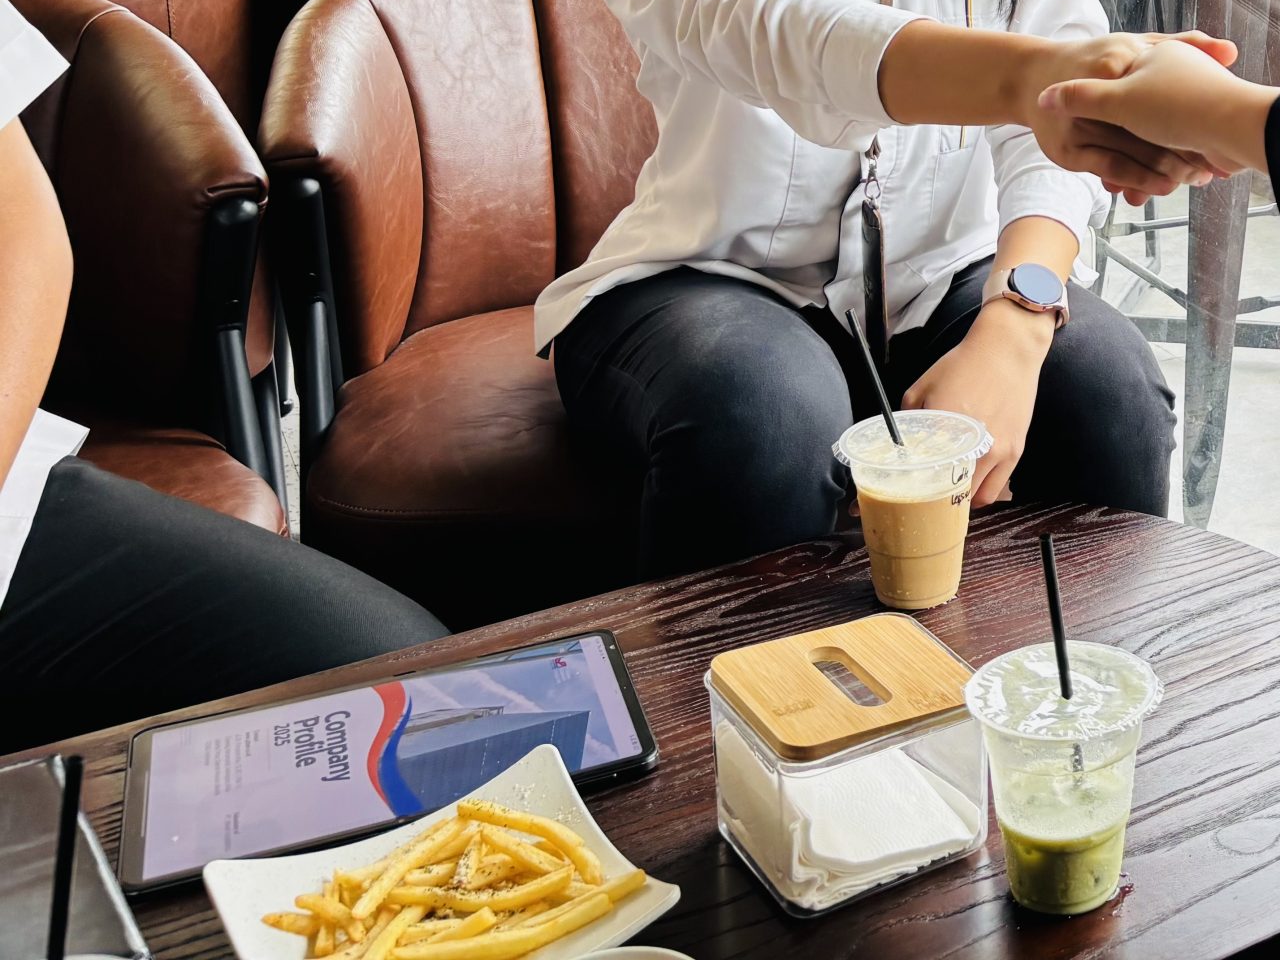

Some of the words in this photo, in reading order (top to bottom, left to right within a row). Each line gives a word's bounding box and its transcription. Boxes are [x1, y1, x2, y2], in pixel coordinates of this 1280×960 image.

[273, 722, 291, 747] 2025
[293, 715, 328, 769] Profile
[321, 710, 351, 782] Company
